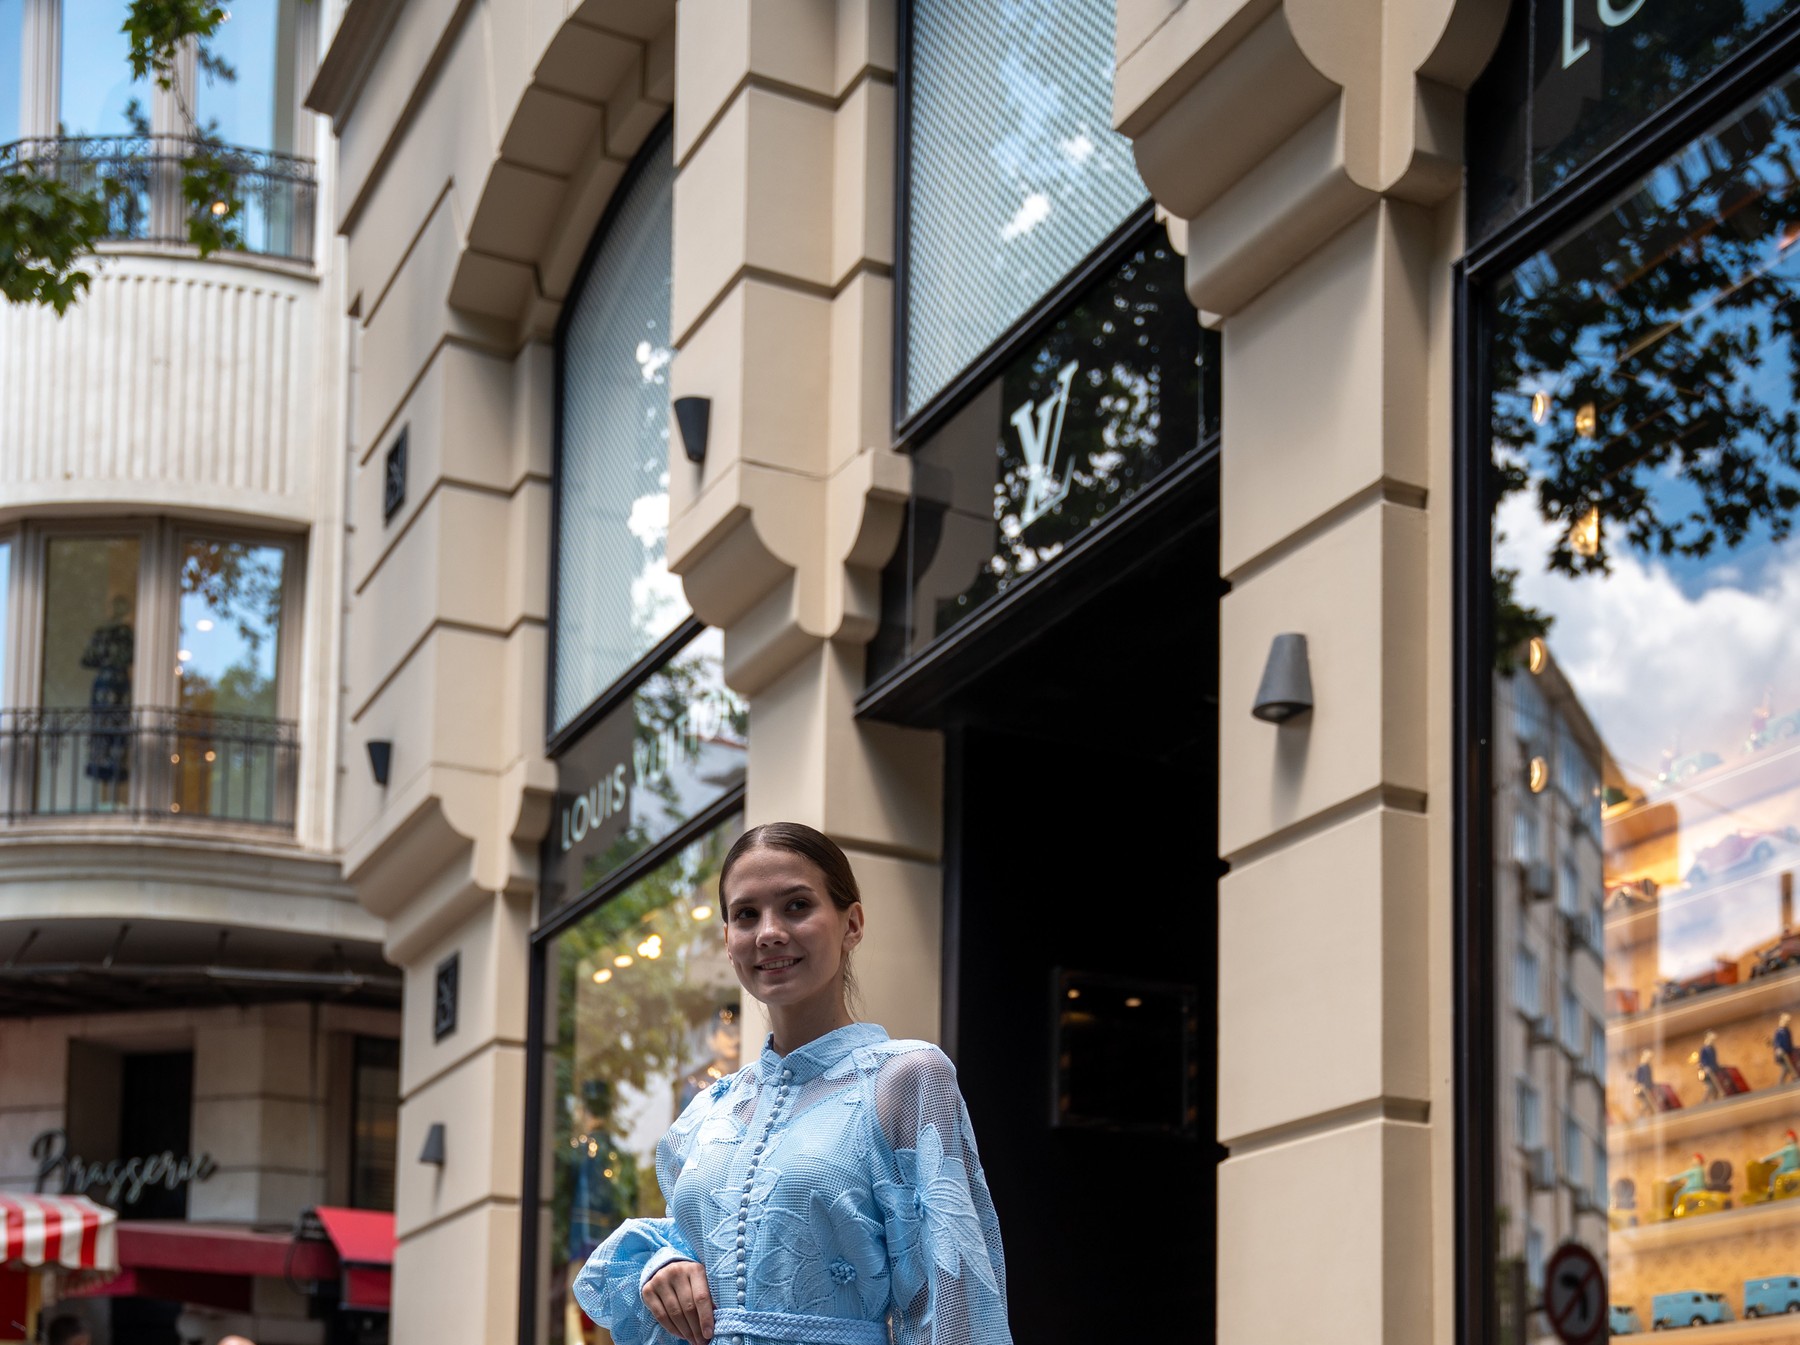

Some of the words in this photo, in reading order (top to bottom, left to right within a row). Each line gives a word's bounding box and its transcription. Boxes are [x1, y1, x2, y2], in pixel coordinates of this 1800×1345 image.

[1562, 0, 1646, 70] L
[561, 763, 627, 852] LOUIS
[31, 1129, 218, 1205] Brasserie
